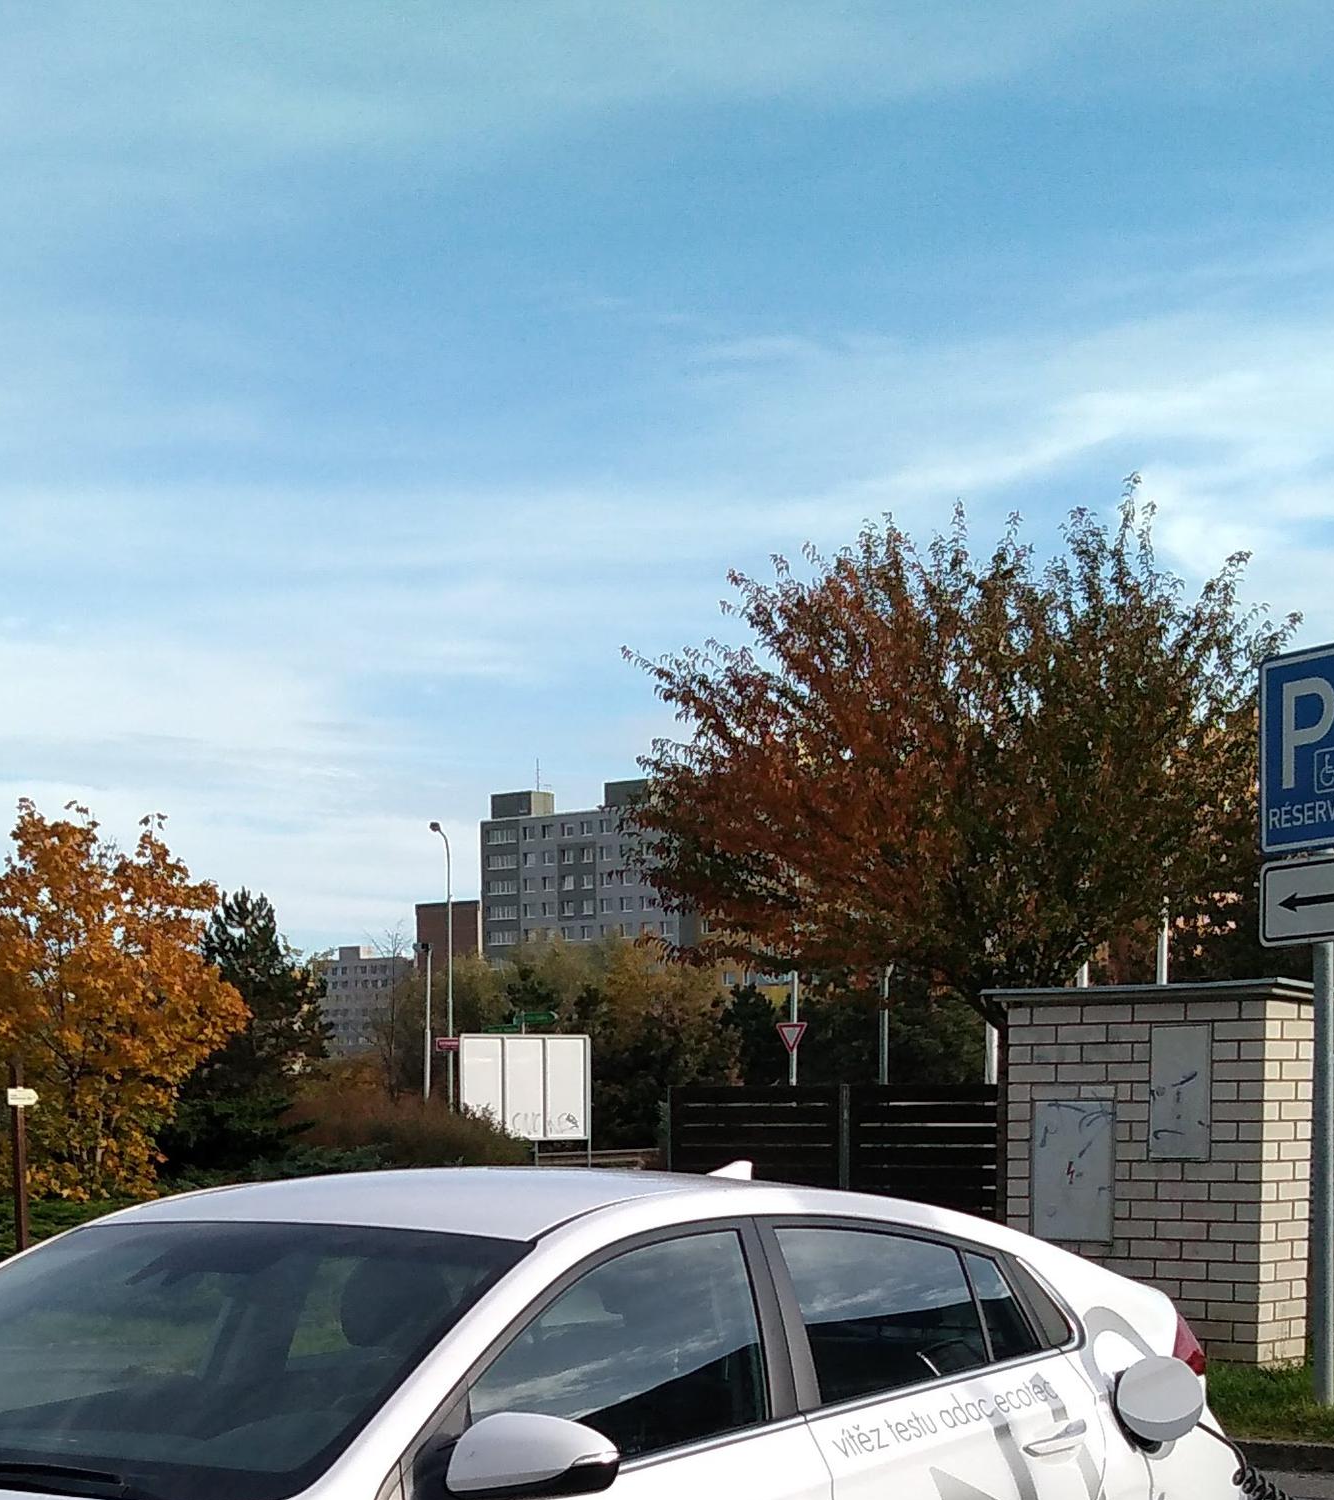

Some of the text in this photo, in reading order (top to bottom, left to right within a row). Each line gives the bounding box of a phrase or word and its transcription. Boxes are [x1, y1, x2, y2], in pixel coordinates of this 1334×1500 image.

[832, 1379, 1059, 1459] vítěz testu adac ecotec
